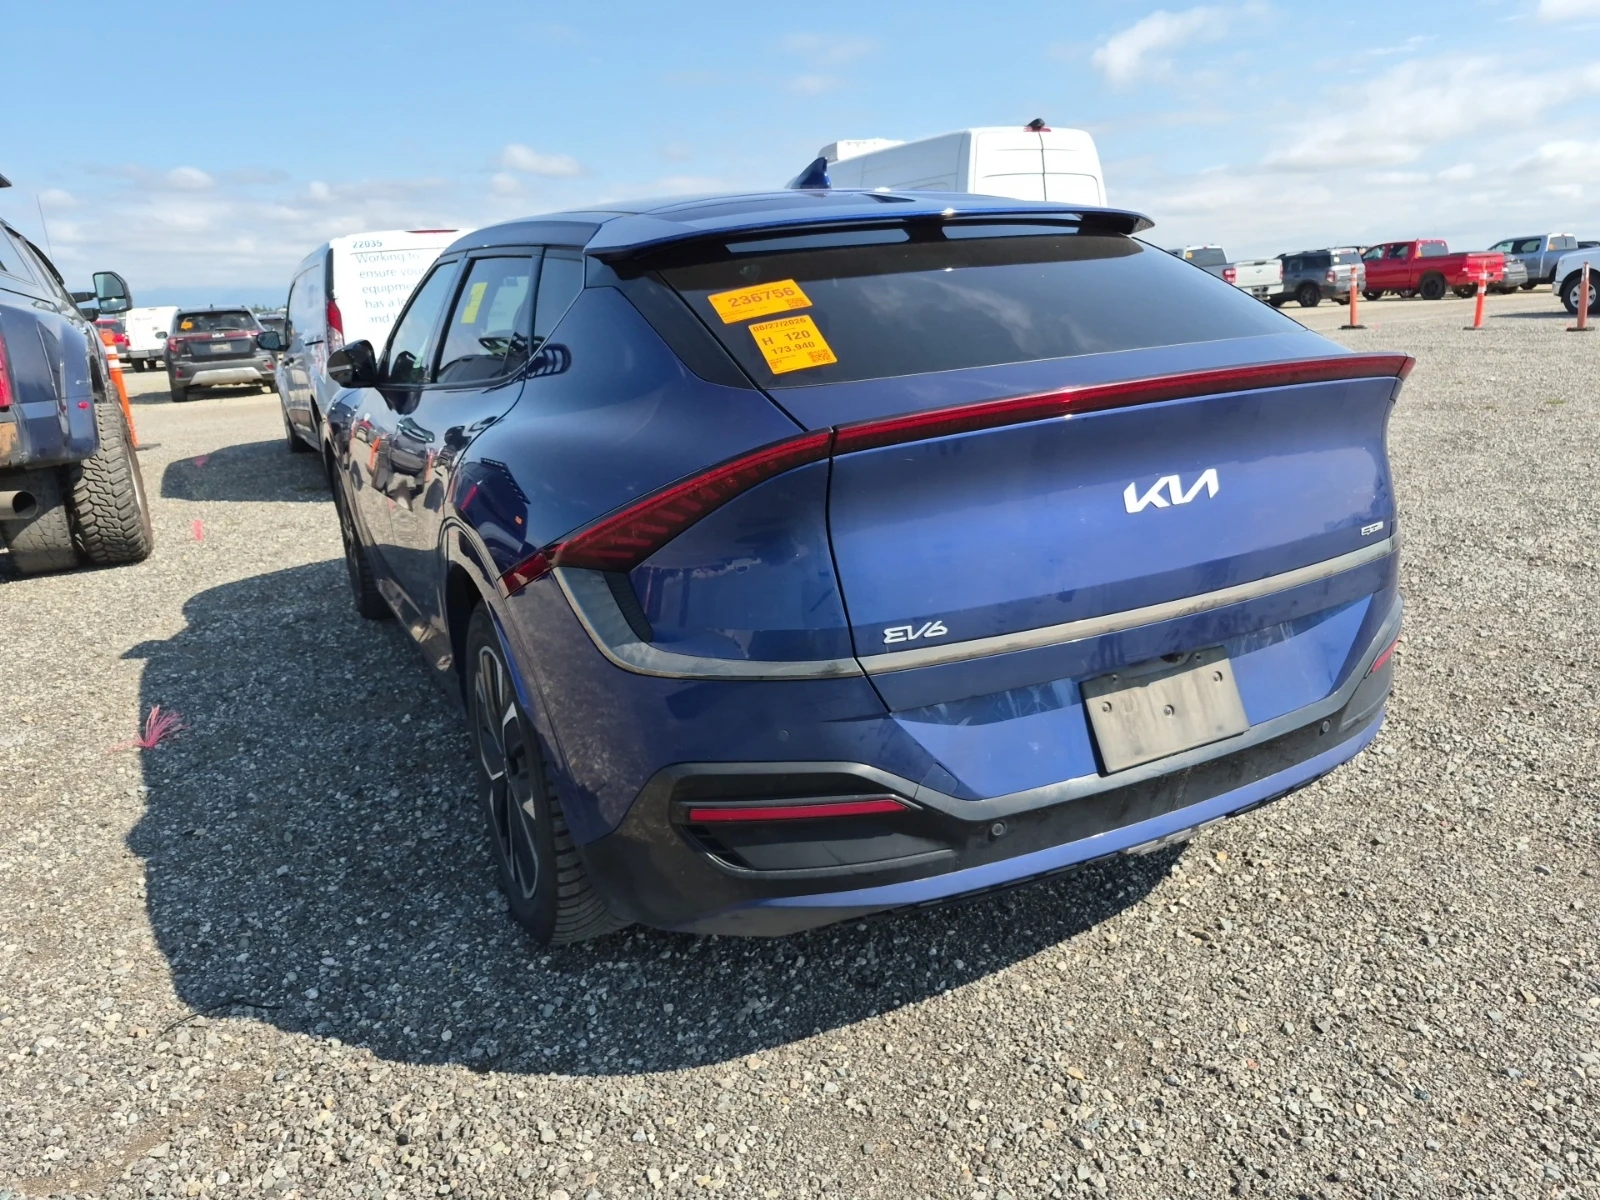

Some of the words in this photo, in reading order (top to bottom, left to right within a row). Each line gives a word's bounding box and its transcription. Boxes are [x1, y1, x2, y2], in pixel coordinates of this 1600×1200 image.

[352, 239, 383, 249] 22035
[355, 251, 405, 264] Working
[407, 252, 420, 260] to
[359, 268, 397, 279] ensure
[364, 298, 385, 309] has
[388, 300, 395, 308] a
[727, 286, 795, 308] 236756
[368, 312, 390, 324] and
[761, 336, 774, 346] H
[784, 329, 811, 341] 120
[771, 341, 816, 355] 173.940
[1123, 468, 1220, 514] KIA
[883, 620, 949, 645] EV6
